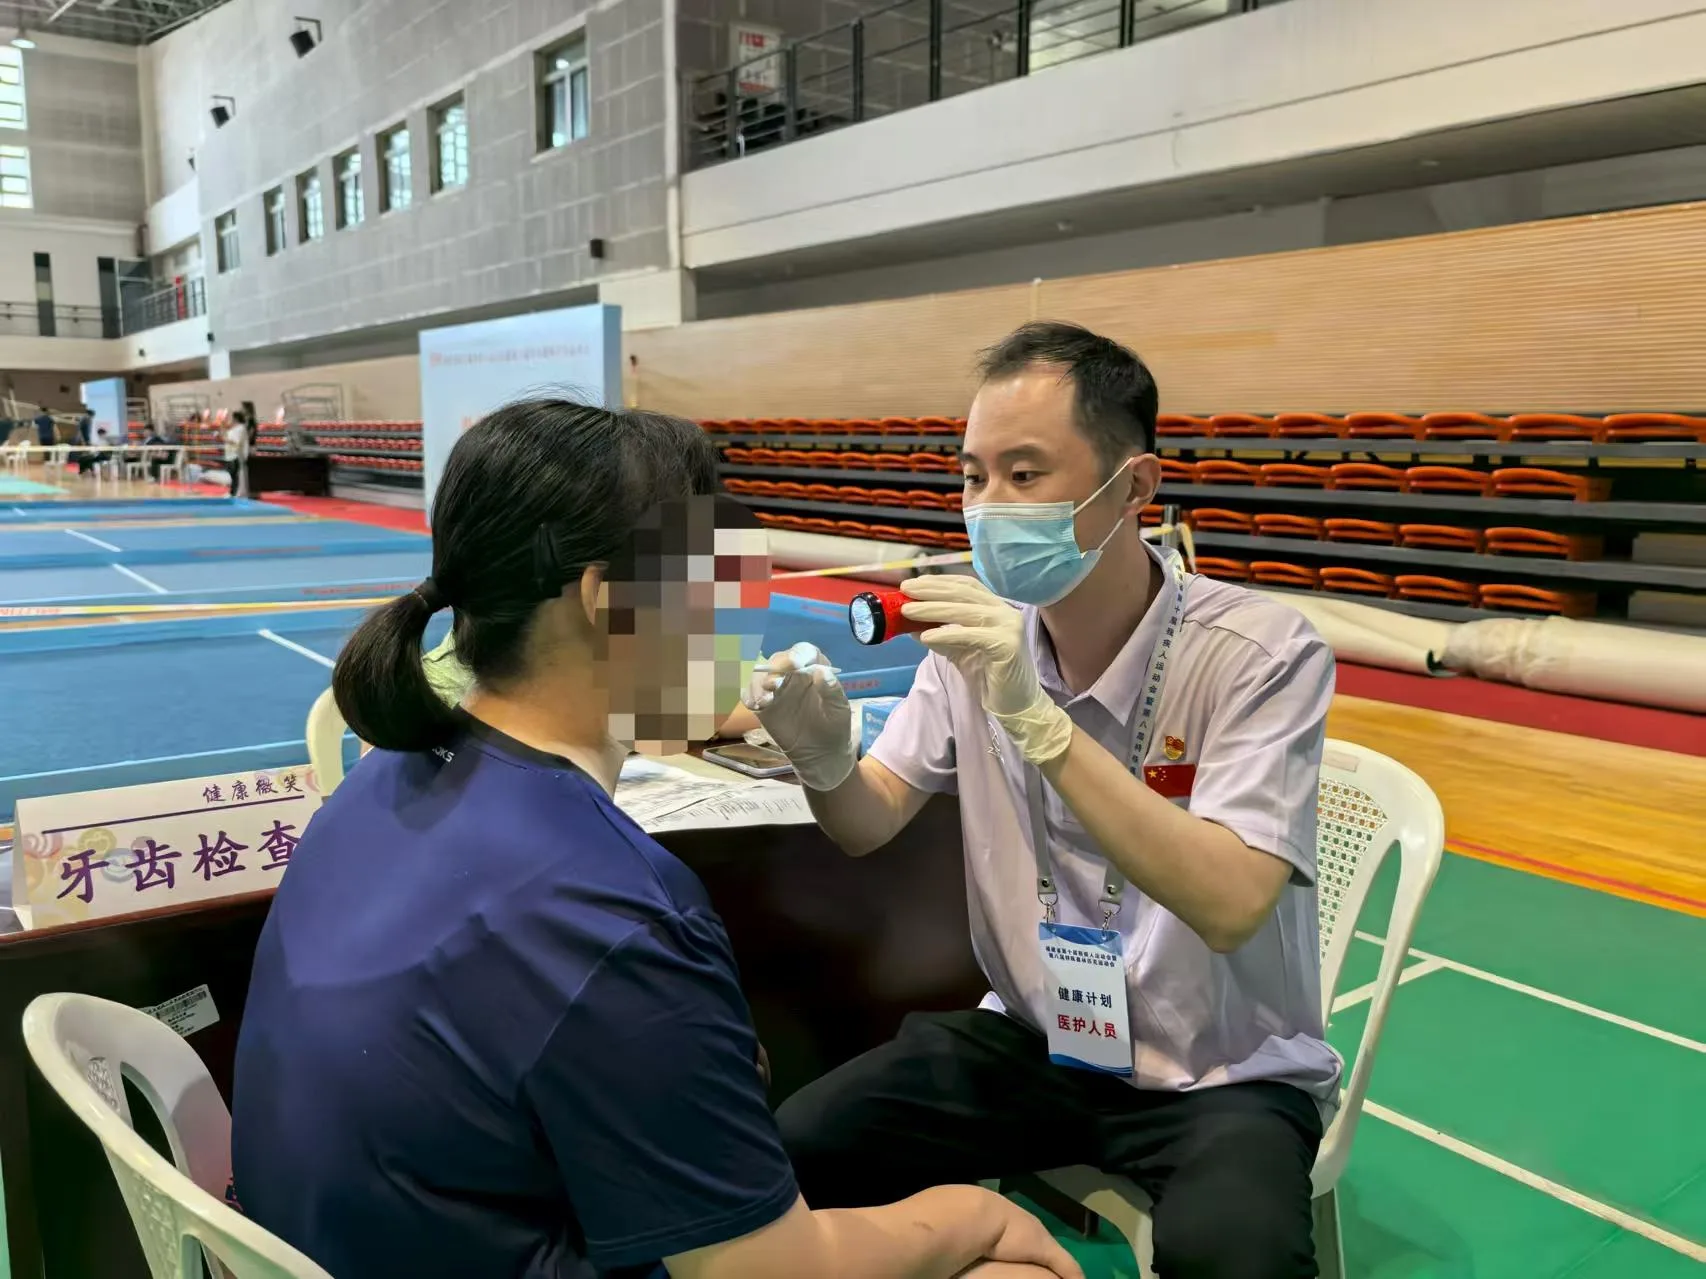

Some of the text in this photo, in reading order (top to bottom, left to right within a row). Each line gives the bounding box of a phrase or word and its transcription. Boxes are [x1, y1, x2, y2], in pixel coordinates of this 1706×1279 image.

[202, 773, 303, 803] 健康微笑
[56, 819, 301, 904] 牙齿检查
[1058, 986, 1113, 1008] 健康计划
[1057, 1014, 1118, 1039] 医护人员
